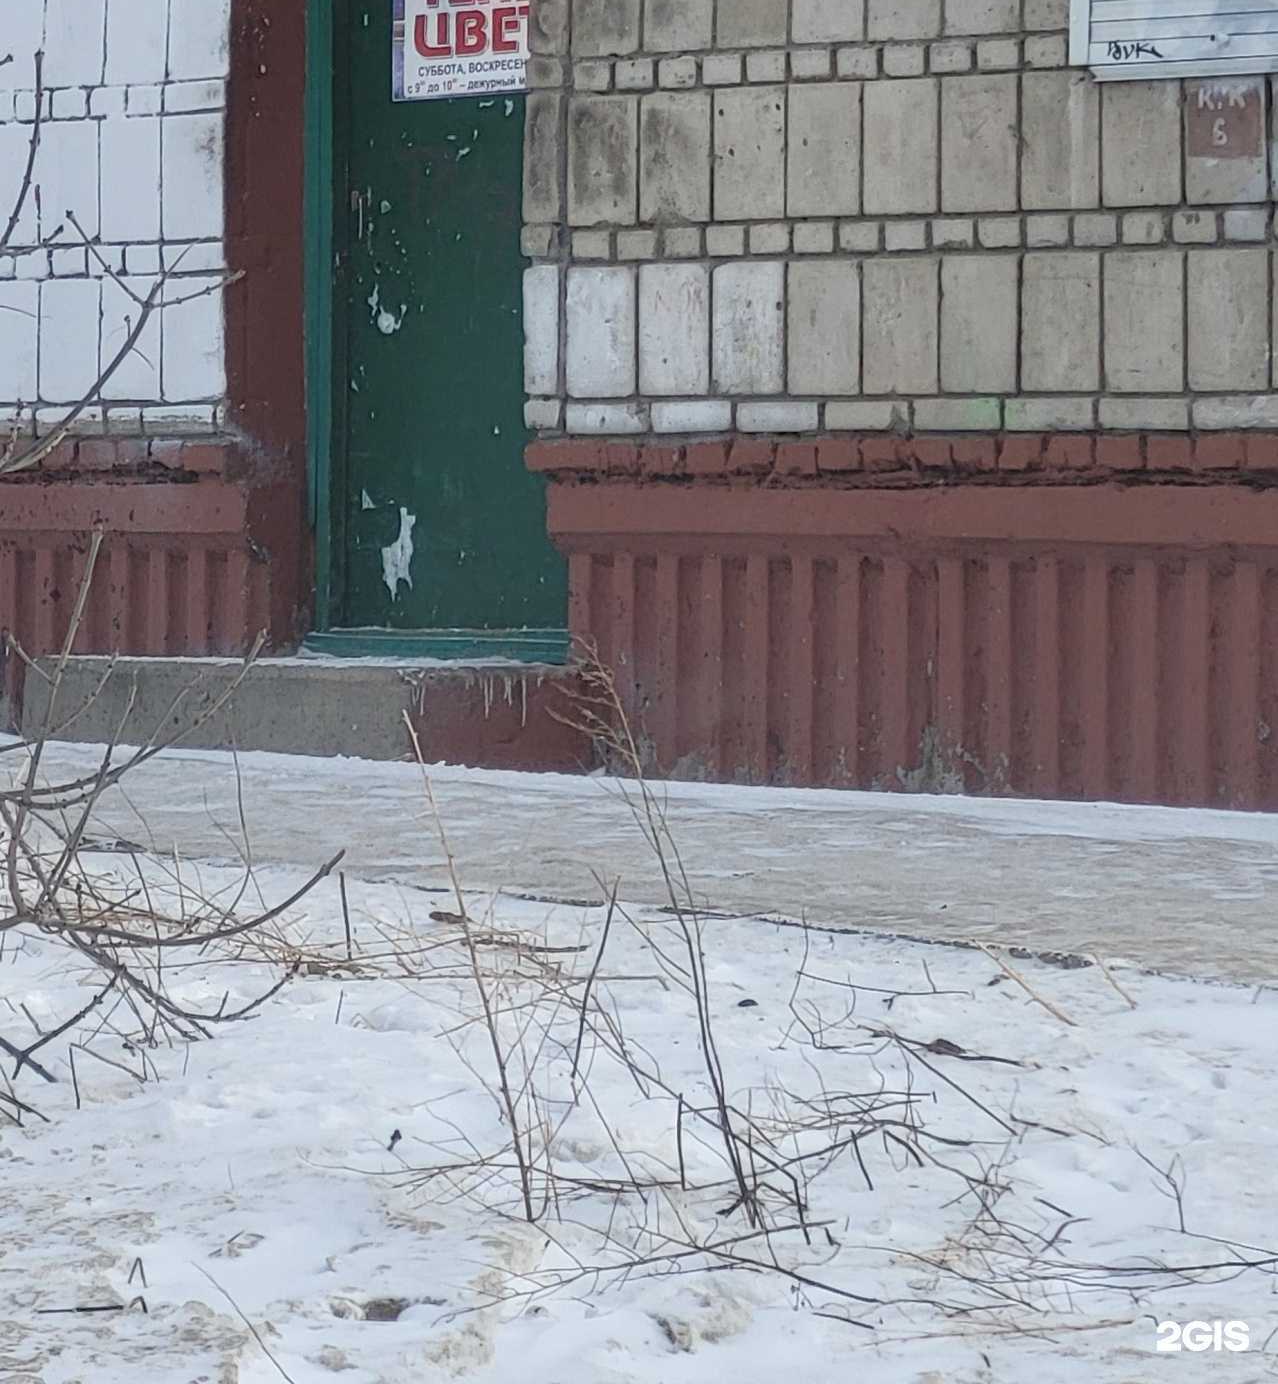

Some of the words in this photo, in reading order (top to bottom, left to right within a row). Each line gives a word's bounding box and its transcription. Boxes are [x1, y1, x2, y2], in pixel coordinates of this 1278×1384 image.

[418, 63, 466, 77] СУББОТА,
[427, 83, 440, 93] до
[467, 75, 516, 90] дежурный
